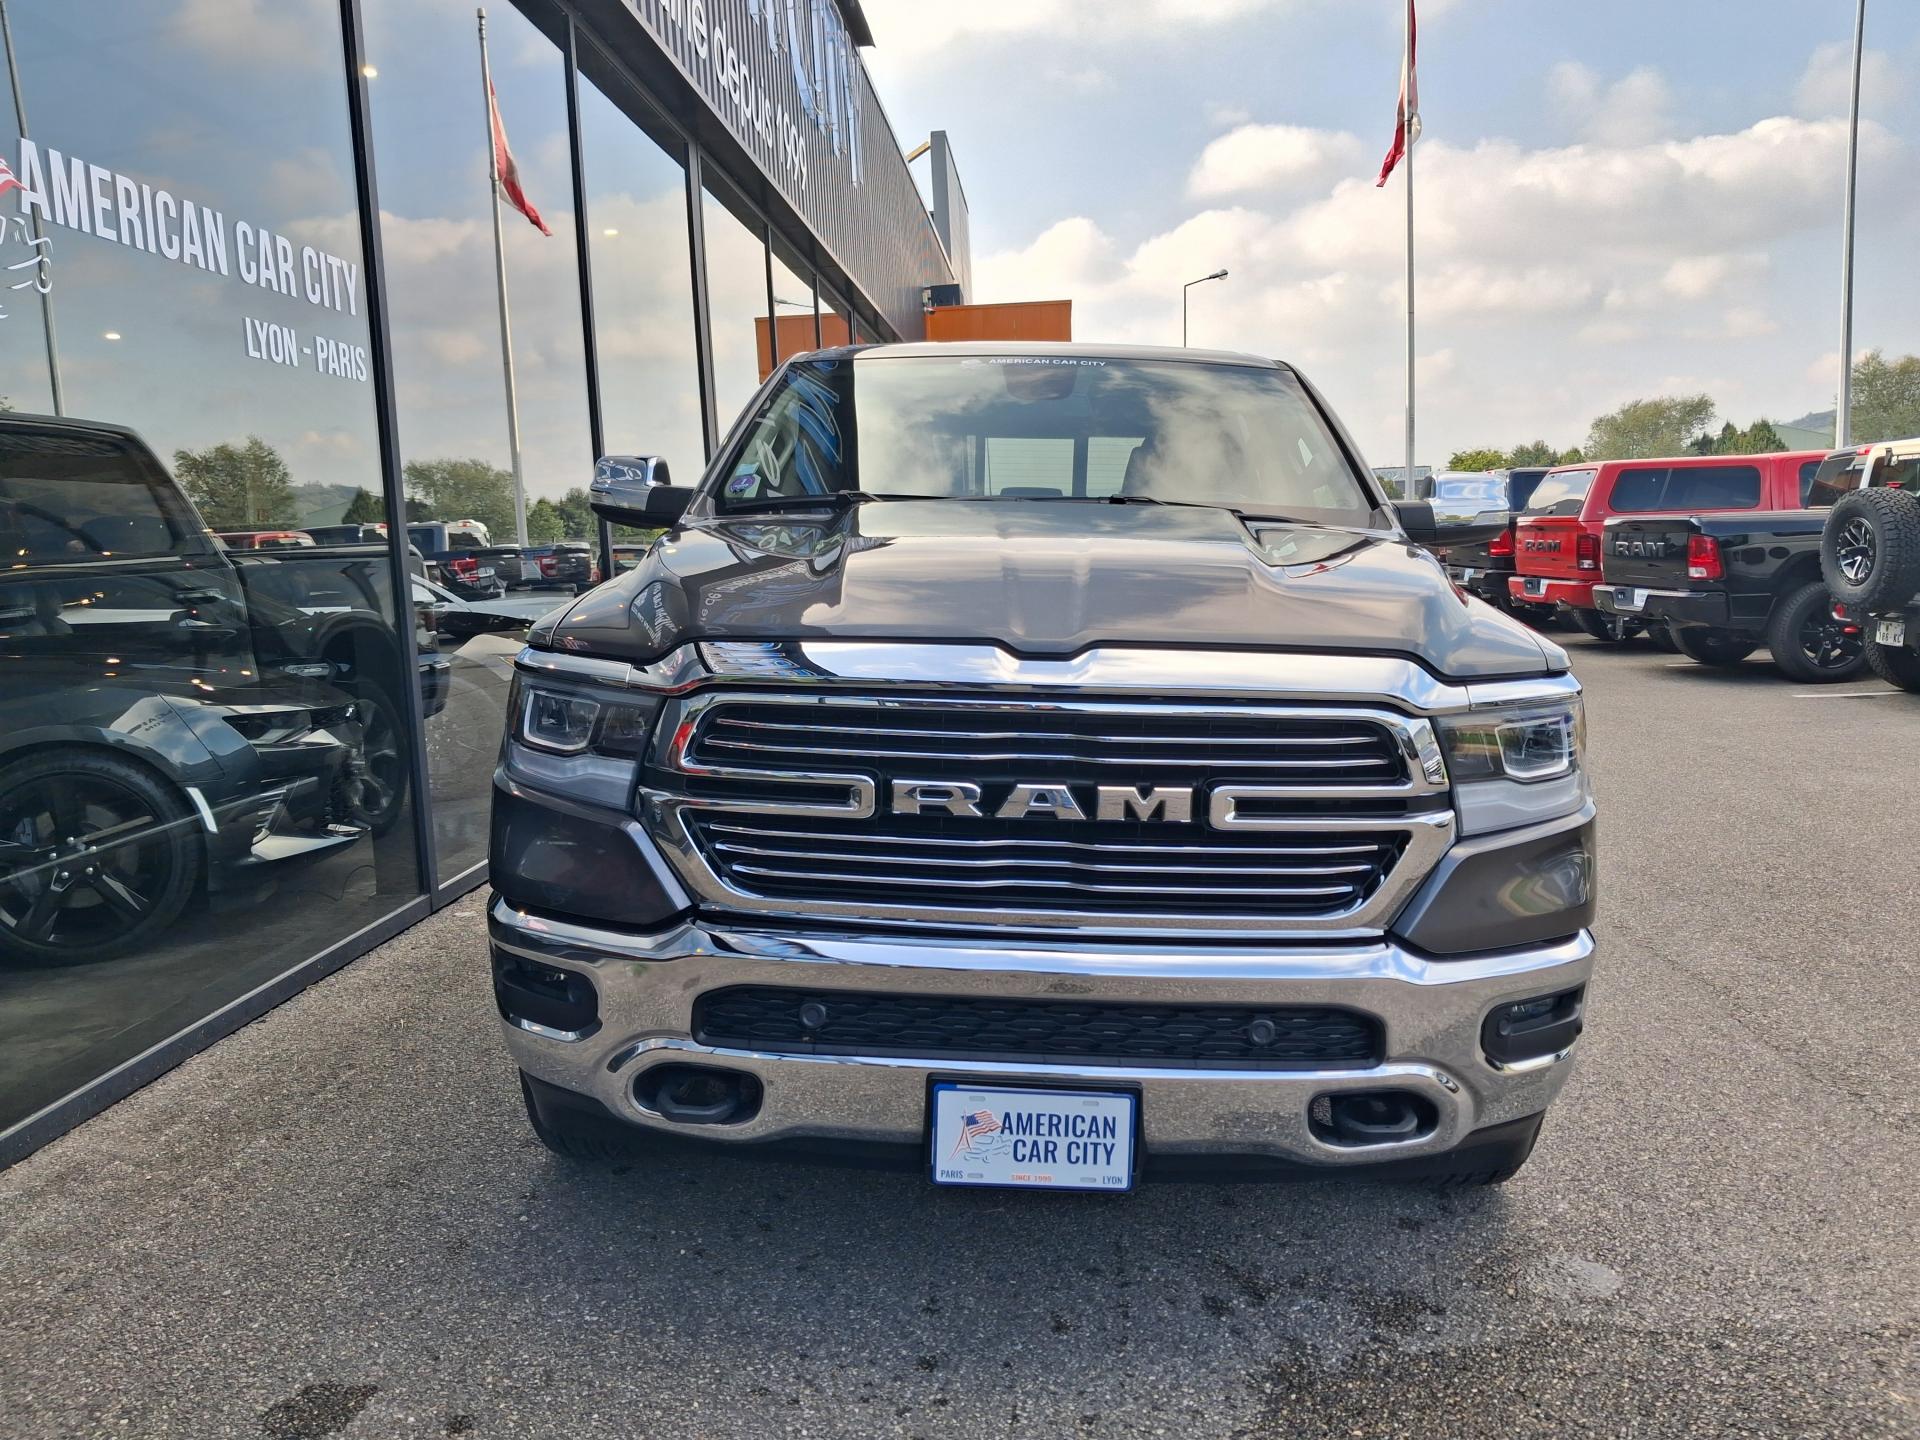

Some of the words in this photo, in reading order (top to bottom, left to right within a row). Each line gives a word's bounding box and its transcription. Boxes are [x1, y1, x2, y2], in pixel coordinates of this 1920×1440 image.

[714, 20, 773, 149] depuis
[776, 104, 807, 190] 1999
[19, 137, 229, 276] AMERICAN
[234, 220, 298, 298] CAR
[302, 245, 358, 316] CITY
[243, 317, 299, 368] LYON
[313, 335, 368, 382] PARIS
[1524, 540, 1561, 553] RAM
[1615, 541, 1665, 557] RAM
[891, 779, 1193, 822] RAM
[1000, 1111, 1117, 1139] AMERICAN
[1013, 1139, 1058, 1164] CAR
[1066, 1141, 1116, 1165] CITY
[940, 1169, 964, 1179] PARIS
[1011, 1174, 1031, 1182] SINCE
[1102, 1175, 1123, 1185] LYON
